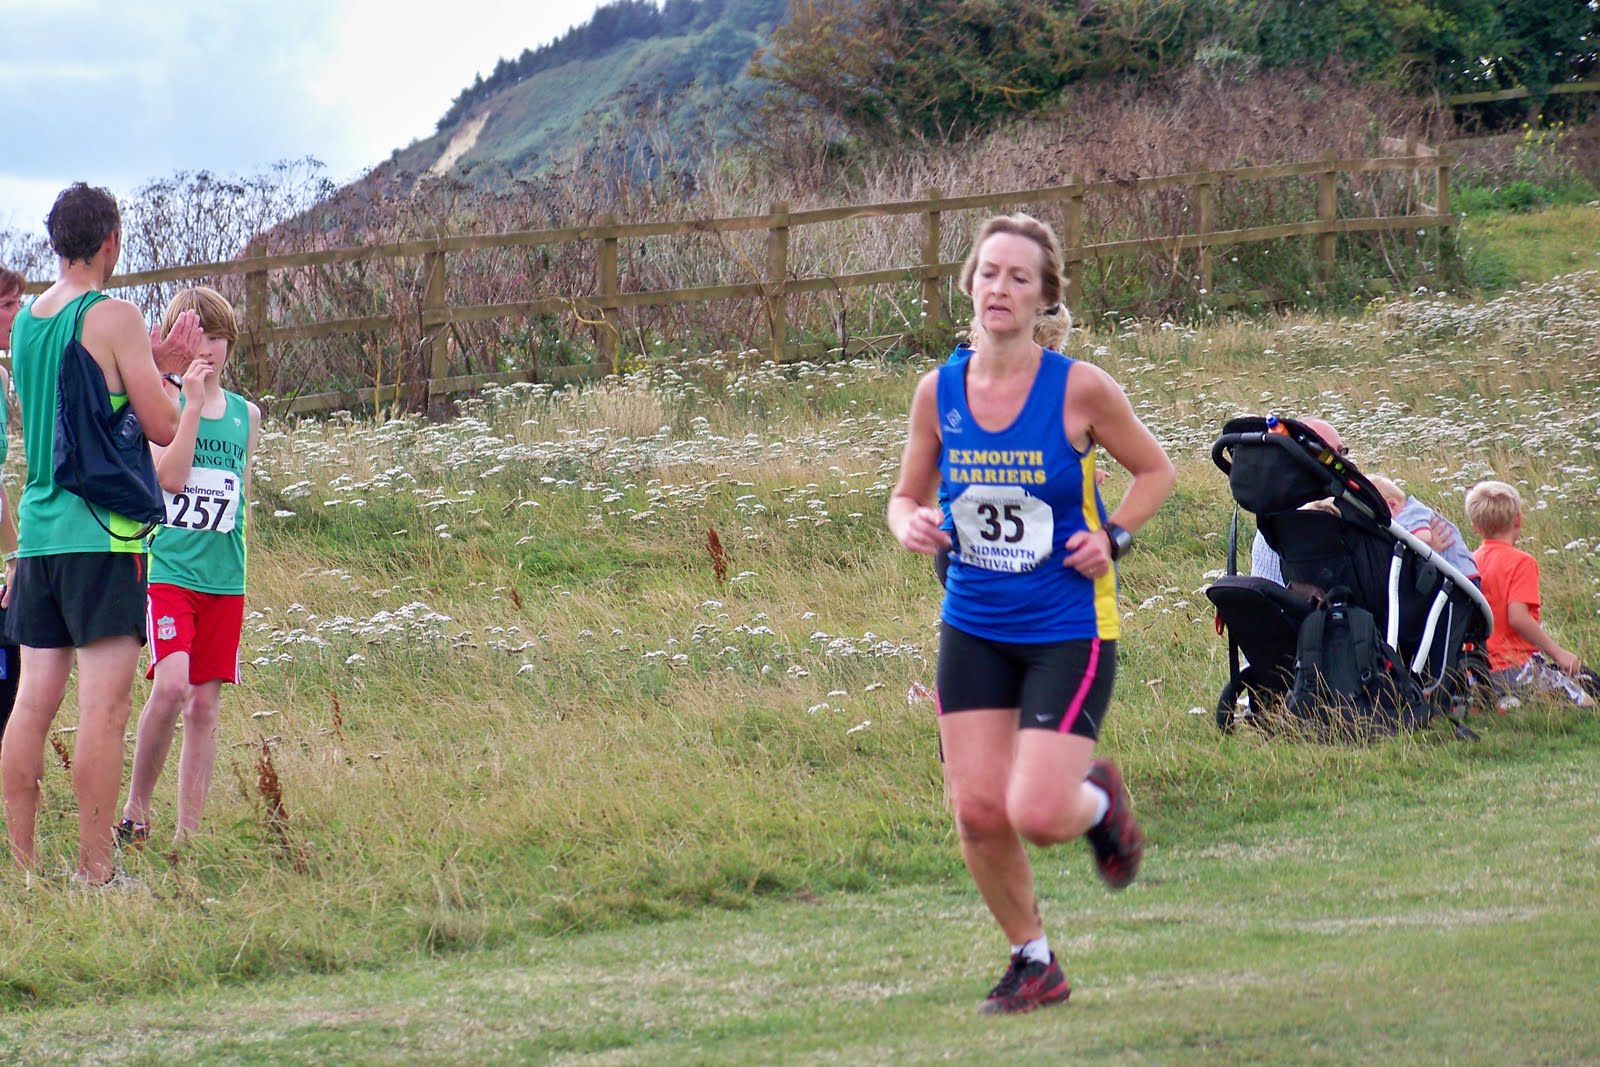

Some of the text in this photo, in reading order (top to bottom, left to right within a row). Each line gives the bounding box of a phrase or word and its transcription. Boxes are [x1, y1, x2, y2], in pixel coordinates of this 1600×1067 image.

[949, 449, 1043, 466] EXMOUTH
[172, 494, 231, 530] 257
[977, 503, 1024, 543] 35
[969, 545, 1036, 560] SIDMOUTH
